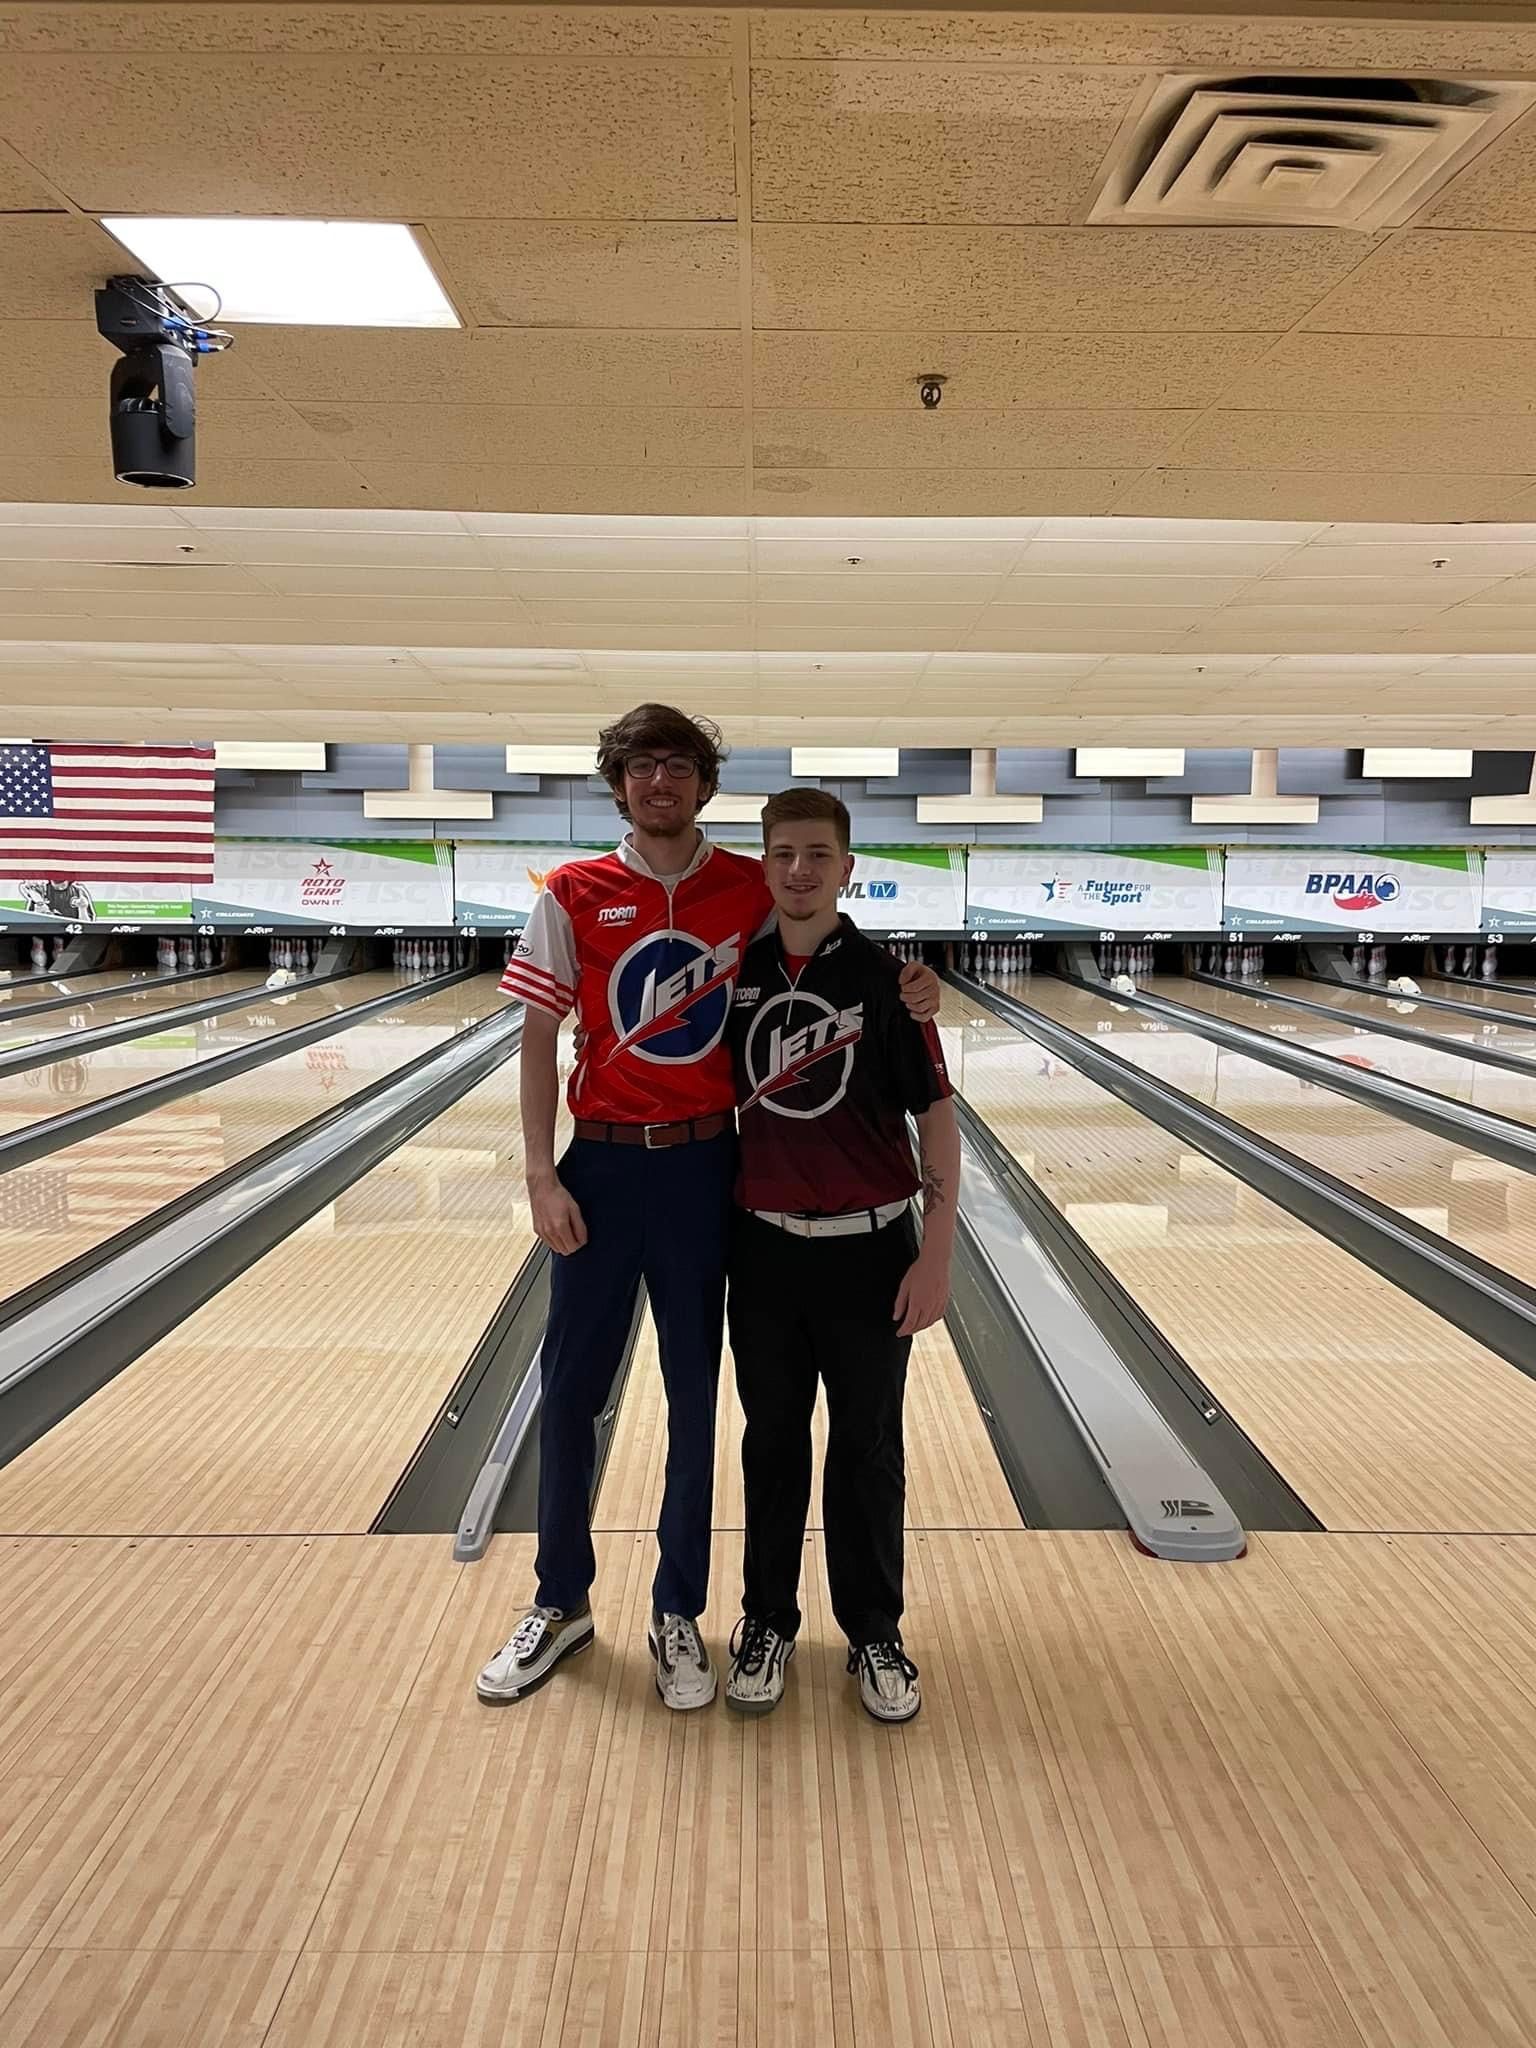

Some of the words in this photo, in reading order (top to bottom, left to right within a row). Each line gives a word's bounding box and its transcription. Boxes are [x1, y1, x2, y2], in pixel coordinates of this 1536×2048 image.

[301, 878, 346, 887] ROTO
[1085, 880, 1133, 892] Future
[1305, 874, 1374, 894] BPAA
[303, 888, 343, 896] GRIP
[837, 882, 866, 898] WL
[871, 883, 894, 897] TV
[1101, 891, 1143, 905] Sport
[597, 905, 637, 922] STORM
[65, 924, 83, 934] 42
[111, 925, 142, 934] AMF
[198, 925, 215, 935] 43
[243, 926, 274, 935] AMF
[329, 926, 346, 936] 44
[374, 927, 404, 936] AMF
[460, 927, 477, 937] 45
[887, 931, 917, 939] AMF
[971, 931, 988, 941] 49
[1015, 931, 1044, 940] AMF
[1099, 932, 1115, 942] 50
[1143, 932, 1173, 940] AMF
[1229, 932, 1244, 942] 51
[1271, 934, 1302, 942] AMF
[1358, 933, 1374, 943] 52
[1401, 934, 1431, 942] AMF
[1487, 933, 1504, 944] 53
[612, 932, 740, 1050] JETS
[750, 1002, 864, 1095] JETS
